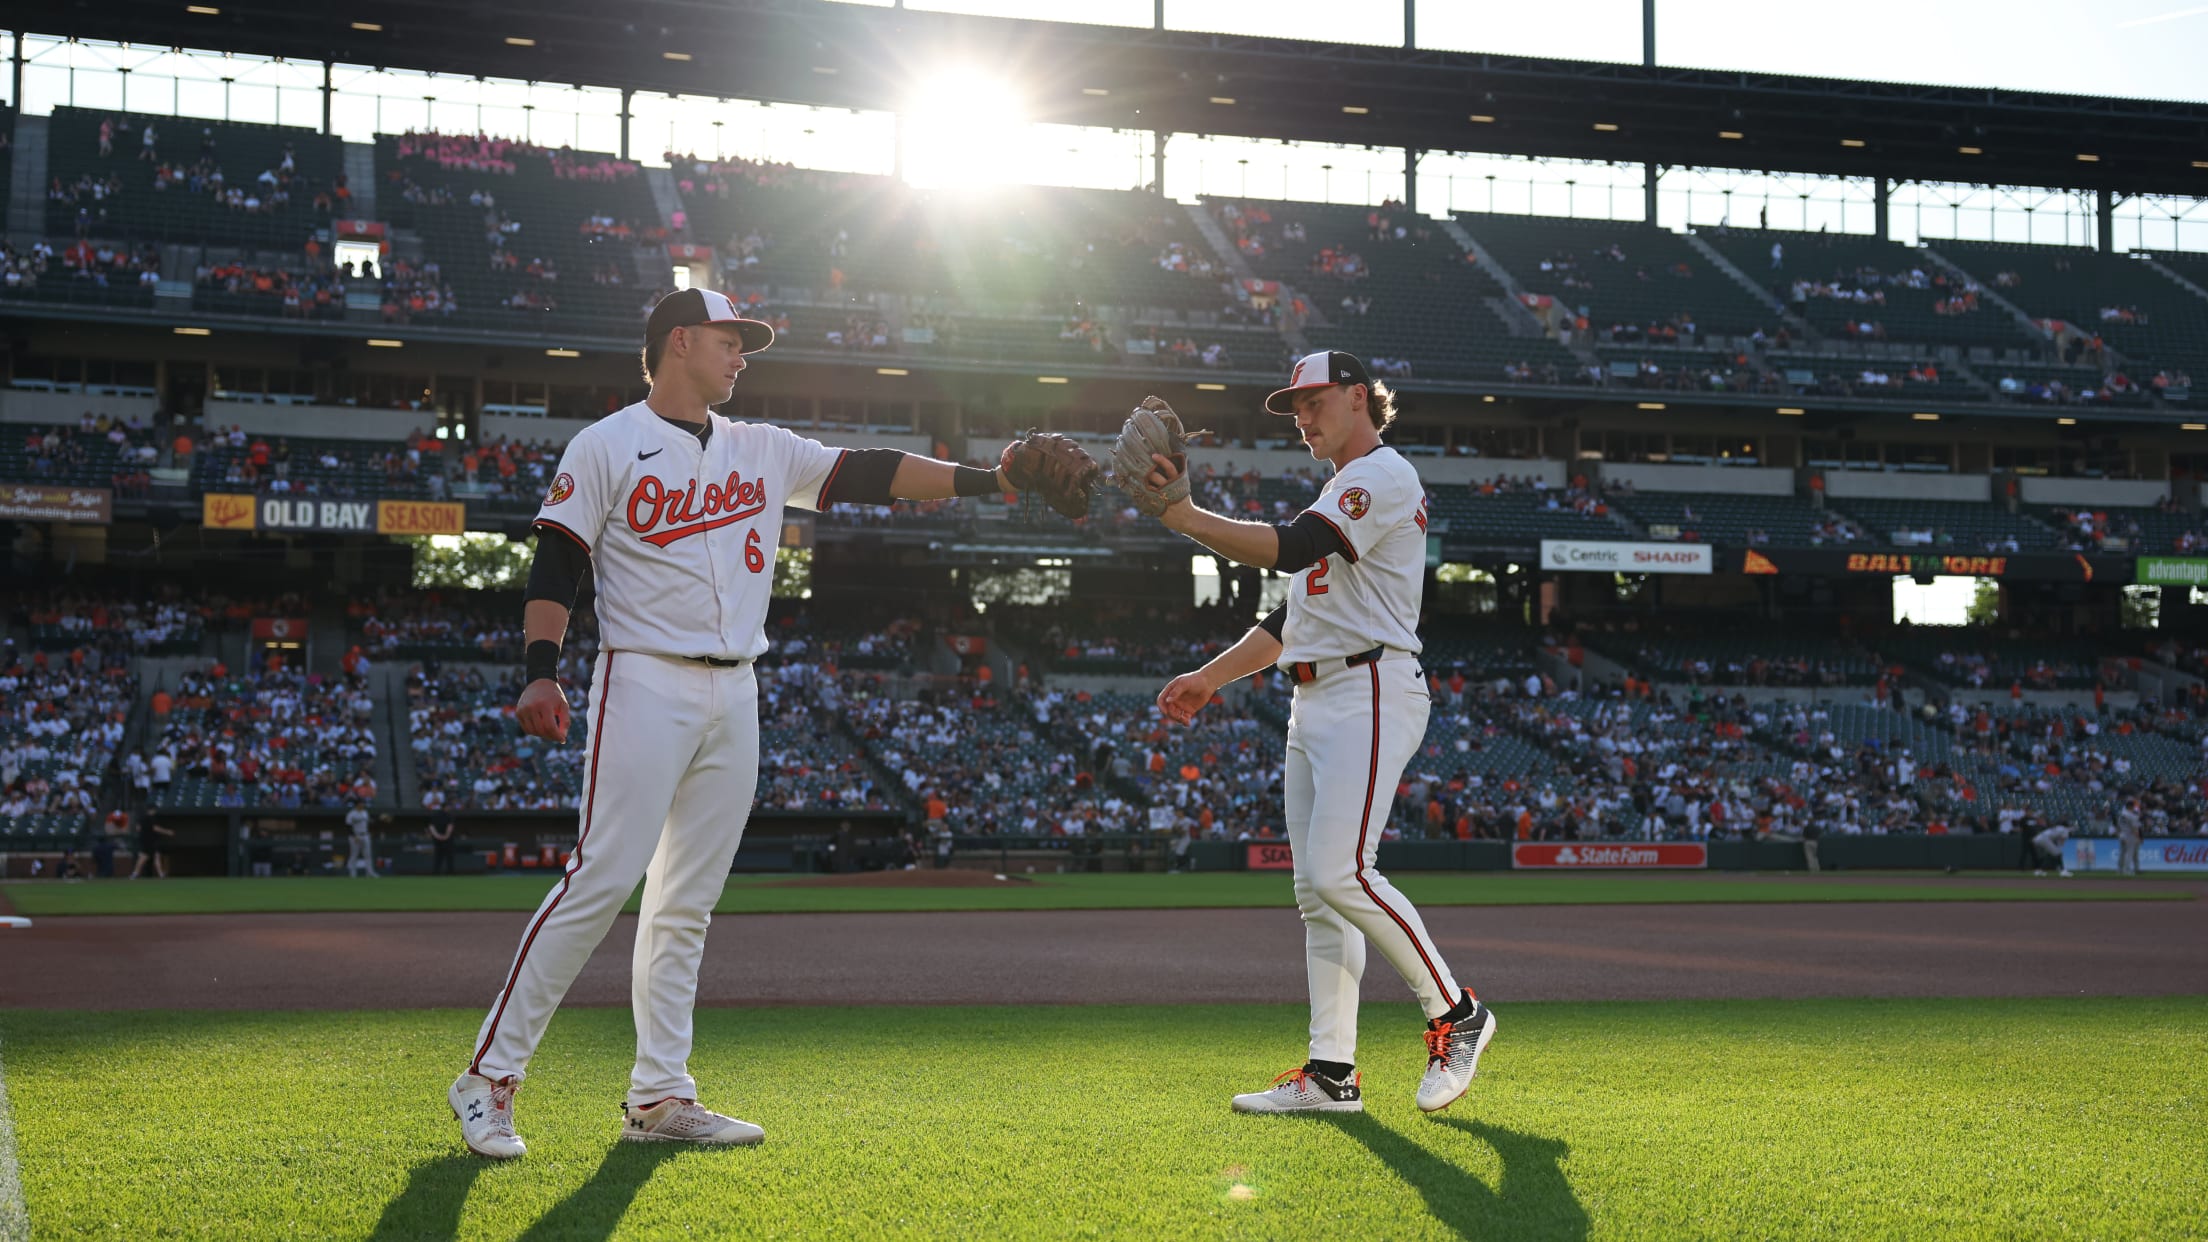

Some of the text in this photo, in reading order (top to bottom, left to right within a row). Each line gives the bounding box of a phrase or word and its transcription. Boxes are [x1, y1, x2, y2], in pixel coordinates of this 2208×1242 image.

[262, 500, 314, 527] OLD
[320, 502, 370, 530] BAY
[384, 505, 457, 532] SEASON
[626, 470, 767, 534] Orioles
[744, 527, 765, 573] 6
[1569, 548, 1619, 562] Centric
[1632, 551, 1700, 563] SHARP
[1306, 556, 1330, 597] 2
[2148, 559, 2208, 585] advantage
[1261, 847, 1293, 865] SEA
